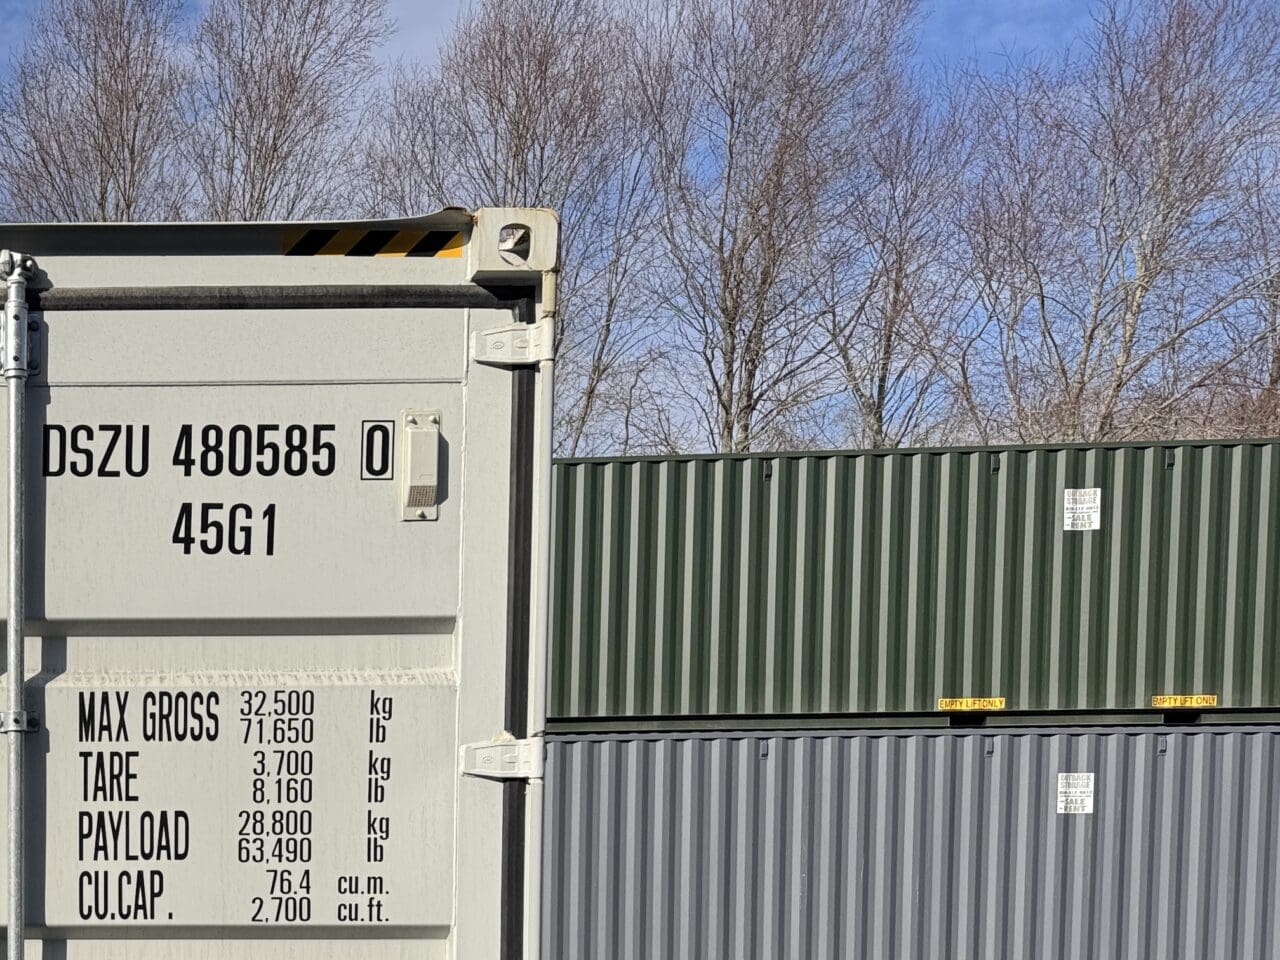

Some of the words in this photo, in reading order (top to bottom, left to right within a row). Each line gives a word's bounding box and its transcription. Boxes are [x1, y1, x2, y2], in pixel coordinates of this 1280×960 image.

[42, 424, 150, 477] DSZU
[172, 424, 336, 477] 480585
[365, 424, 389, 477] 0
[172, 503, 276, 556] 45G1
[78, 691, 130, 742] MAX
[142, 691, 220, 742] GROSS
[240, 690, 314, 717] 32,500
[370, 689, 393, 720] kg
[939, 699, 963, 708] EMPTY
[982, 699, 1004, 708] ONLY
[1196, 696, 1216, 705] ONLY
[240, 718, 314, 745] 71,650
[368, 718, 387, 744] lb
[79, 751, 140, 802] TARE
[253, 750, 313, 777] 3,700
[368, 750, 392, 780] kg
[252, 778, 313, 804] 8,160
[367, 778, 385, 804] lb
[78, 810, 190, 862] PAYLOAD
[238, 810, 312, 837] 28,800
[367, 810, 390, 840] kg
[237, 838, 312, 865] 63,490
[366, 838, 384, 863] lb
[78, 870, 174, 921] CU.CAP.
[266, 869, 311, 895] 76.4
[337, 874, 390, 895] cu.m.
[251, 896, 311, 923] 2,700
[336, 897, 390, 923] cu.ft.
